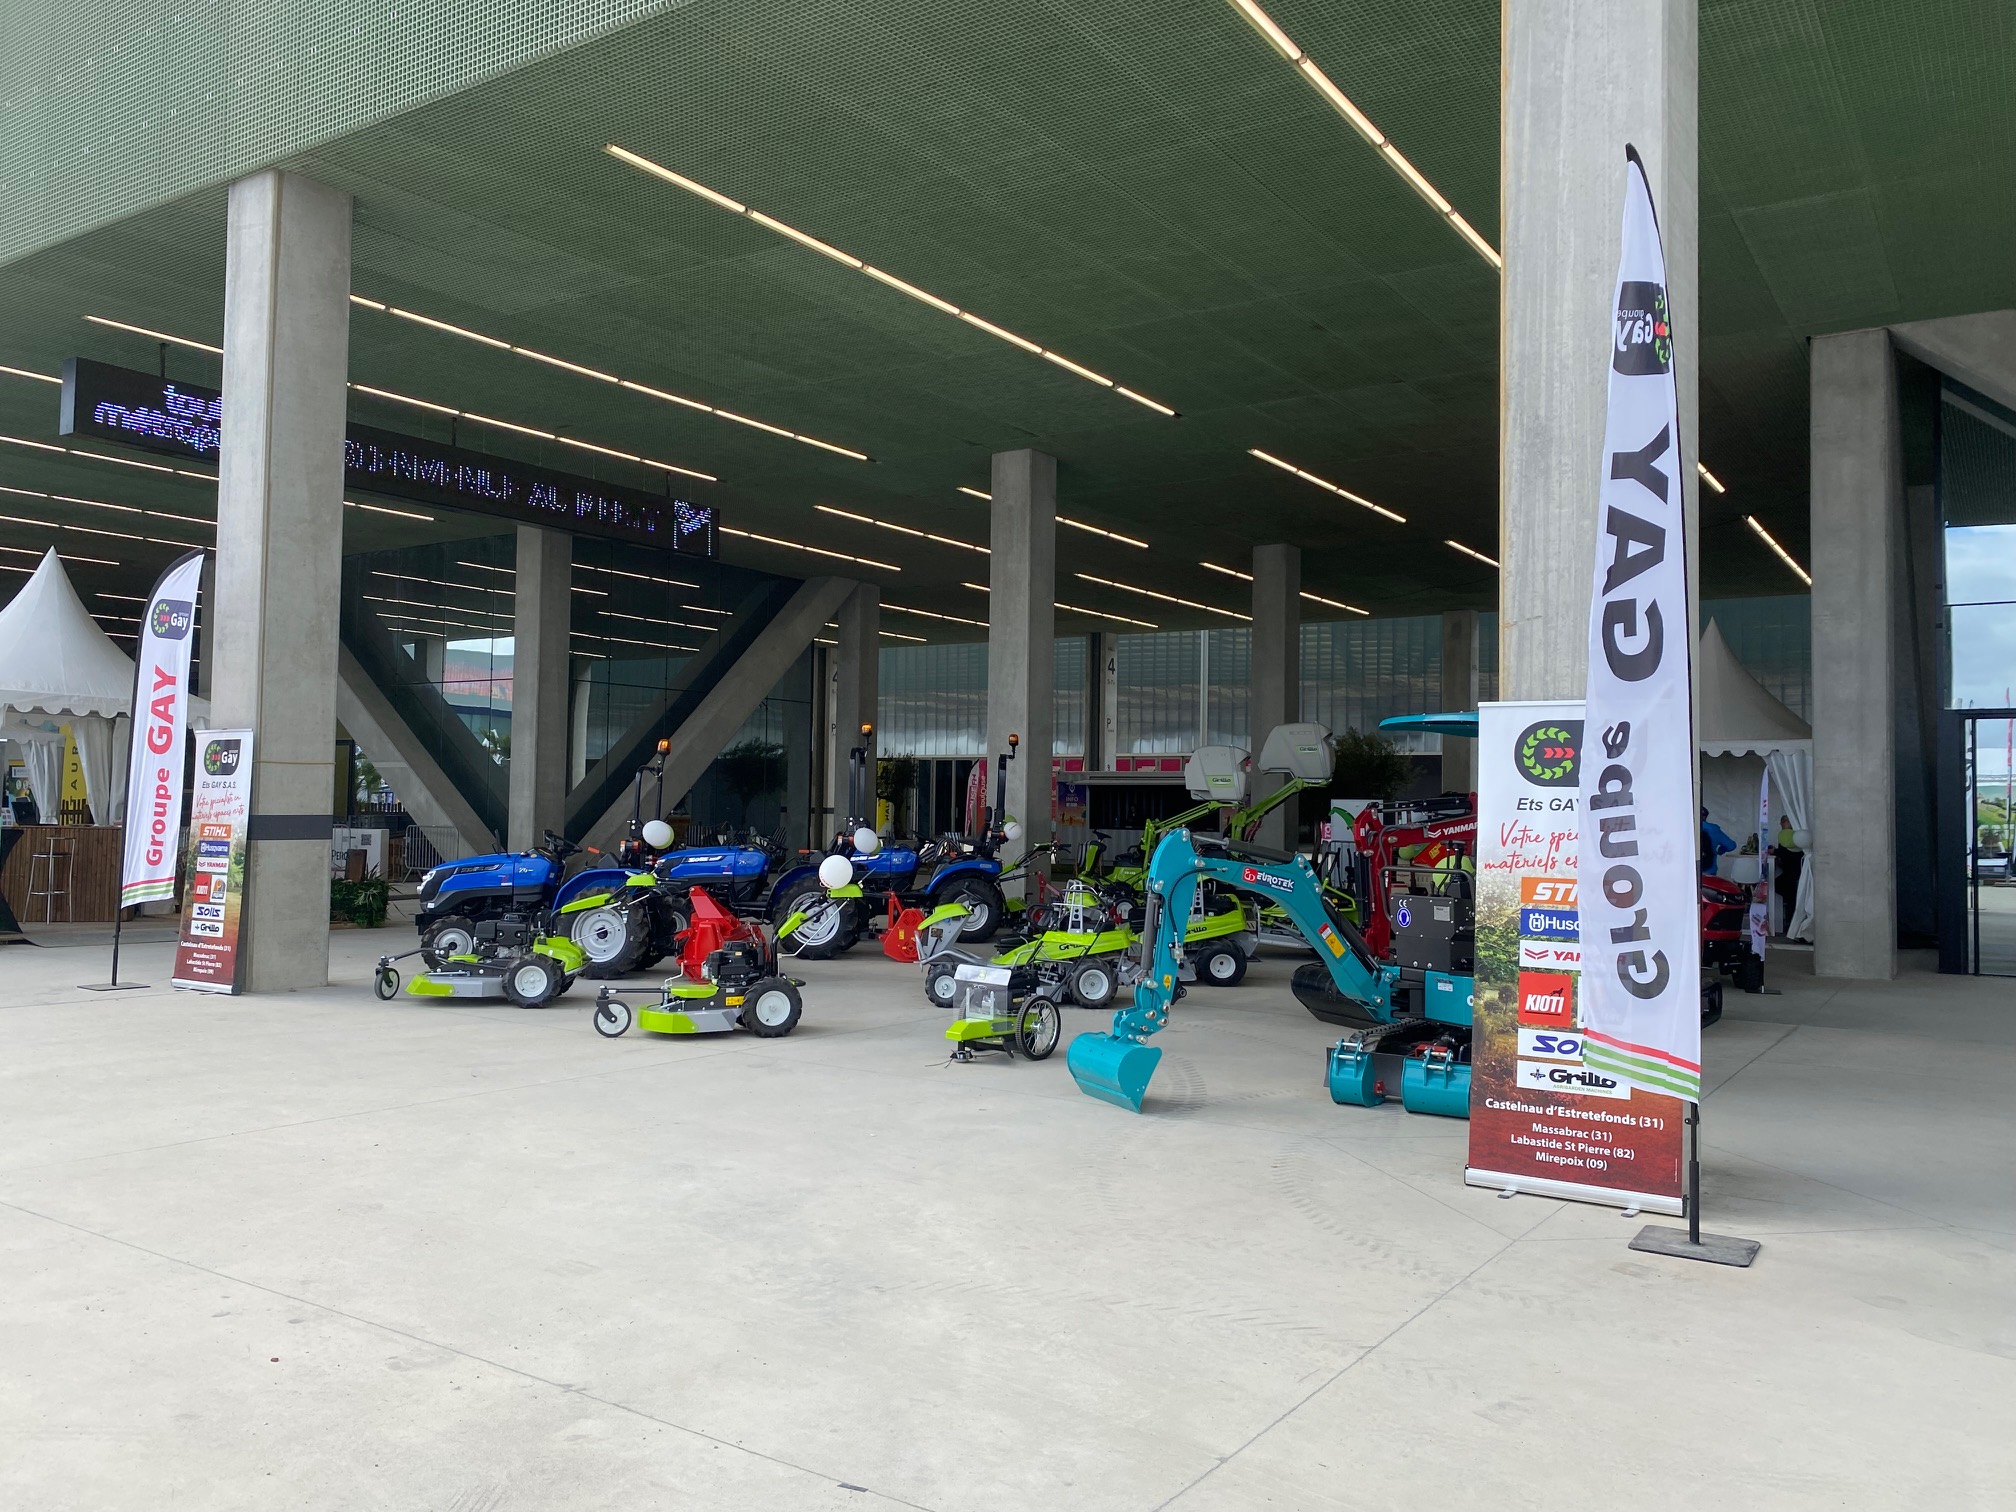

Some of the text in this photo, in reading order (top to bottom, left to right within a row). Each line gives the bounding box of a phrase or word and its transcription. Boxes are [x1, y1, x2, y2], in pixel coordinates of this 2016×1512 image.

[170, 612, 188, 630] Gay
[1108, 657, 1115, 675] 4
[146, 664, 176, 867] Groupe GAY
[221, 751, 238, 767] Gay
[1517, 798, 1543, 811] Ets
[203, 826, 227, 837] STIHL
[1501, 819, 1545, 847] Votre
[1484, 848, 1558, 873] matériels
[1257, 871, 1294, 888] EUROTEK
[1525, 994, 1564, 1013] KIOTI
[1549, 1068, 1617, 1088] Grillo
[1586, 1087, 1612, 1095] MACHINES
[1485, 1098, 1543, 1114] Castelnau
[1639, 1117, 1664, 1131] (31)
[1532, 1122, 1613, 1143] Massabrac (31)
[1511, 1134, 1635, 1161] Labastide St Pierre (82)
[1536, 1152, 1608, 1172] Mirepoix (09)
